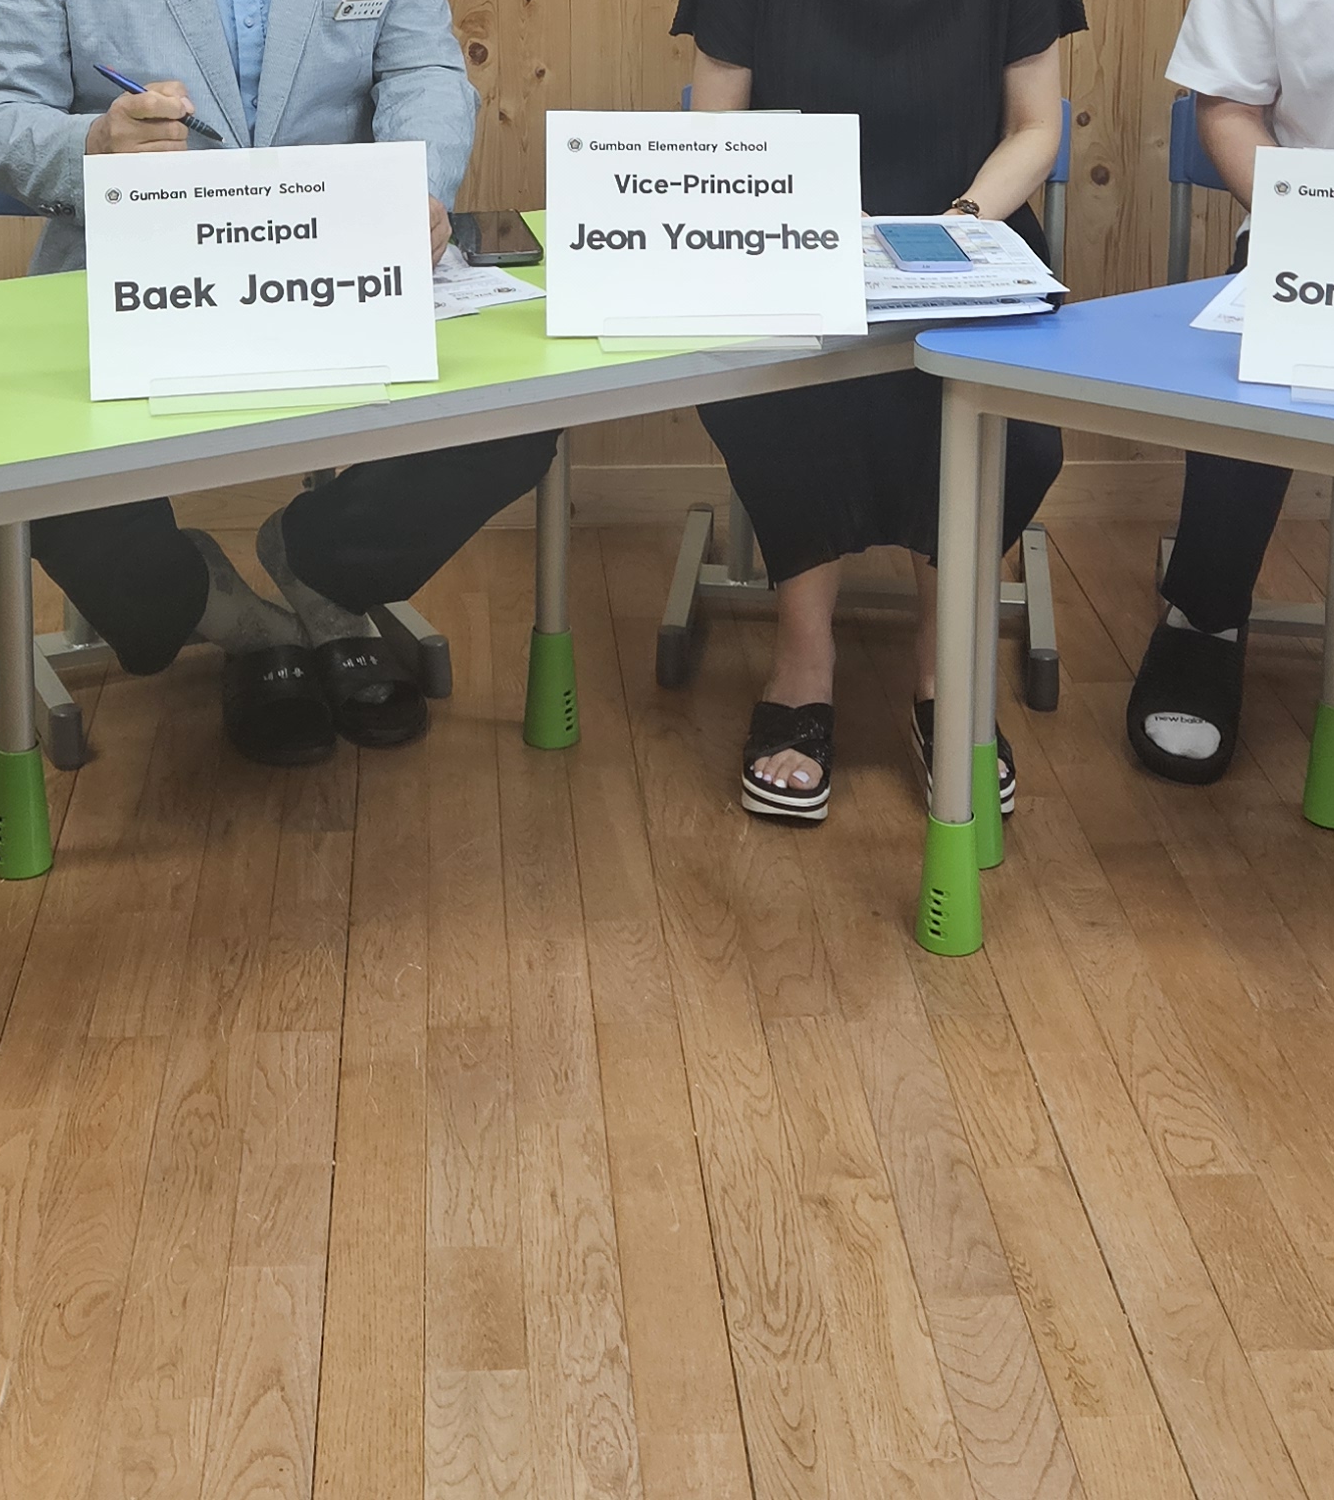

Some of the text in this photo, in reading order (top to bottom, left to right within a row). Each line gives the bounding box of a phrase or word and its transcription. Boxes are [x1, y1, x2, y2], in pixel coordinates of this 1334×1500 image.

[589, 141, 767, 153] Gumban Elementary School
[129, 182, 325, 202] Gumban Elementary School
[614, 174, 793, 197] Vice-Principal
[197, 218, 317, 246] Principal
[569, 223, 839, 256] Jeon Young-hee
[115, 266, 402, 312] Baek Jong-pil
